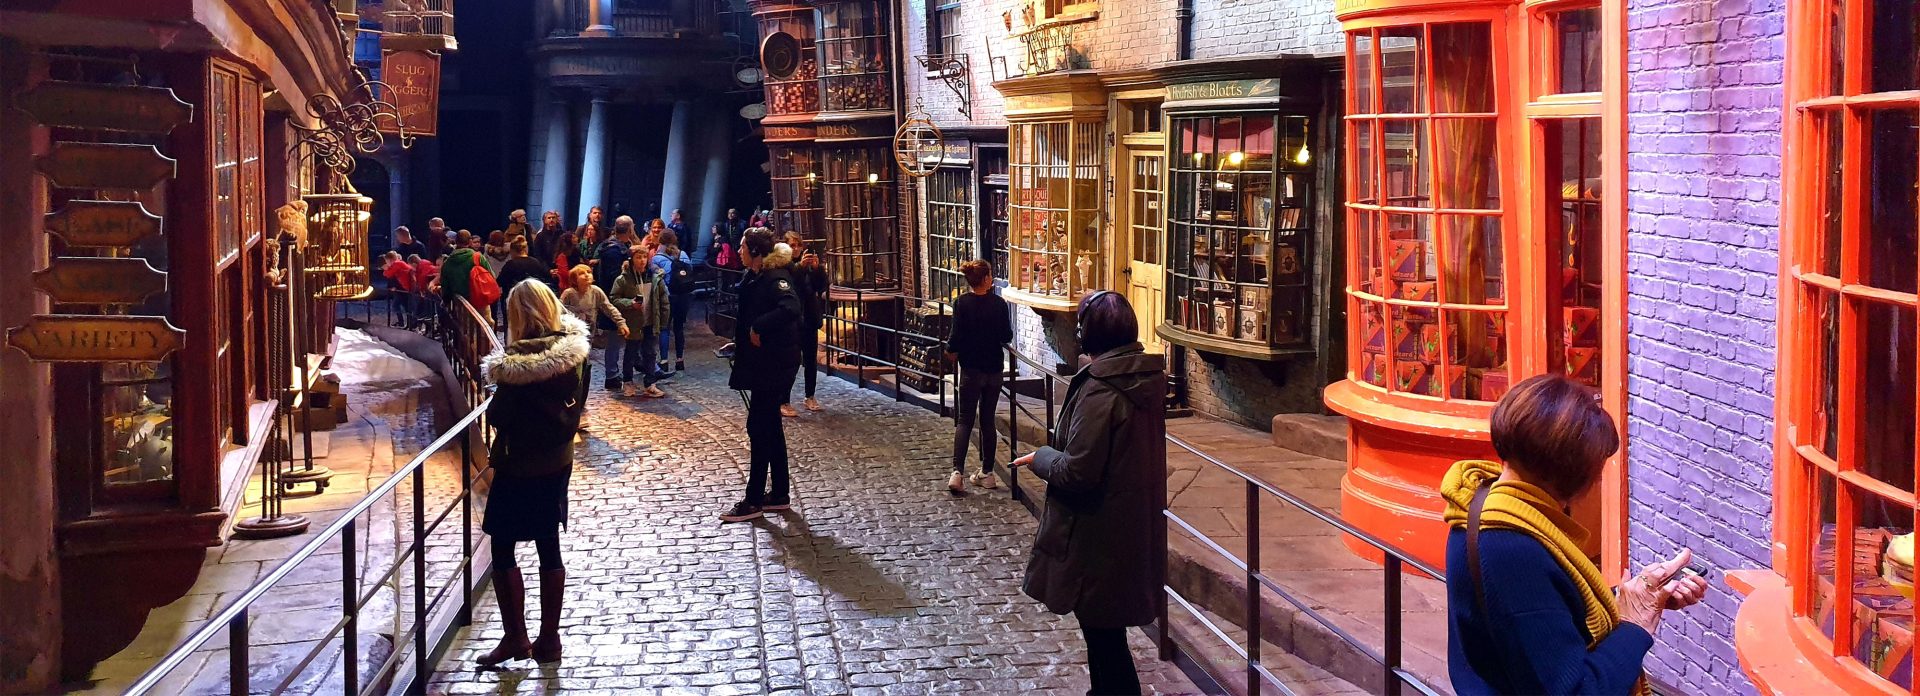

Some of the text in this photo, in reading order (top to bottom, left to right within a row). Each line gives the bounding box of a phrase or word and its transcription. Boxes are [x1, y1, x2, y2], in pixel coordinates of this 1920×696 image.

[395, 64, 425, 76] SLUG
[1209, 82, 1243, 97] Blotts
[31, 329, 158, 349] VARIETY
